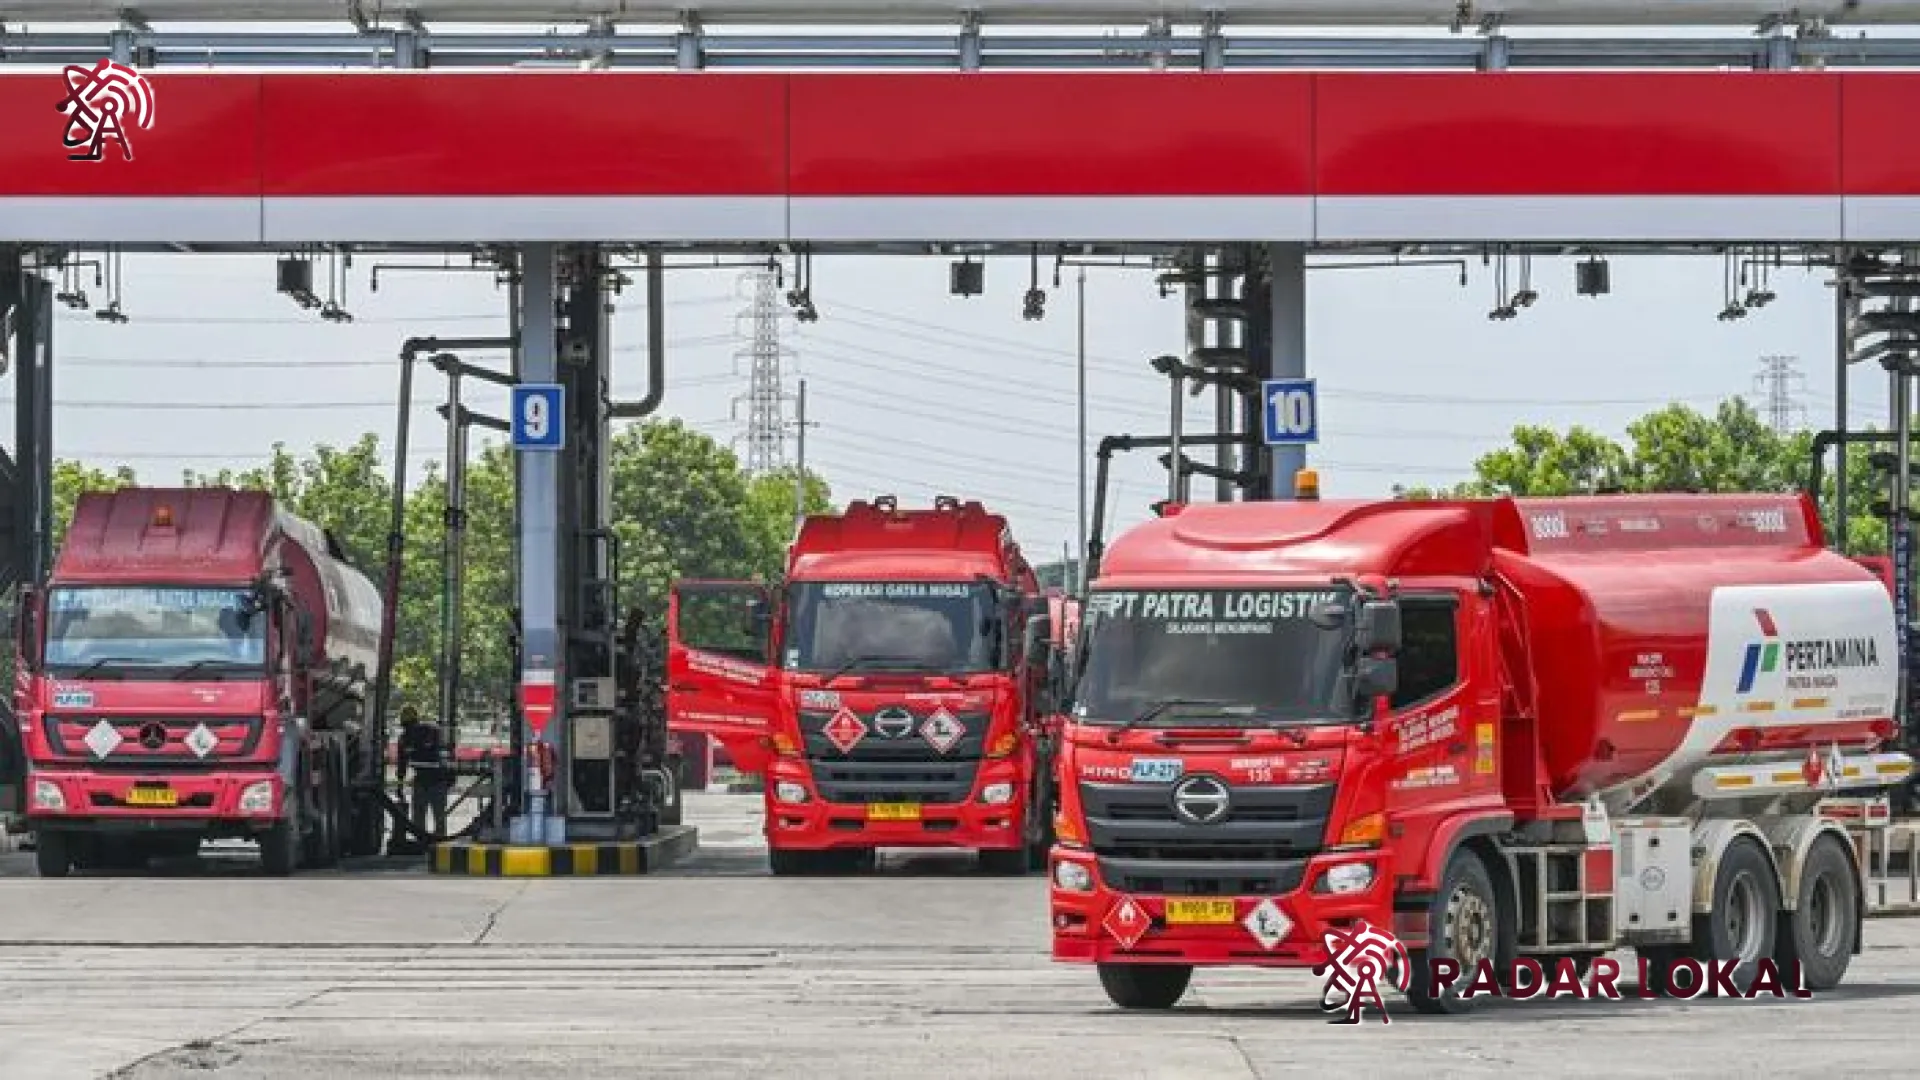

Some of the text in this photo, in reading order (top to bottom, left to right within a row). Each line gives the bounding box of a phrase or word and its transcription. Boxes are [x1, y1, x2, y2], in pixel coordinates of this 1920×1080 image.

[524, 394, 549, 439] 9
[1270, 390, 1311, 435] 10
[1107, 591, 1138, 618] PT
[1143, 591, 1214, 618] PATRA
[1785, 637, 1879, 671] PERTAMINA
[1082, 764, 1130, 779] HINO
